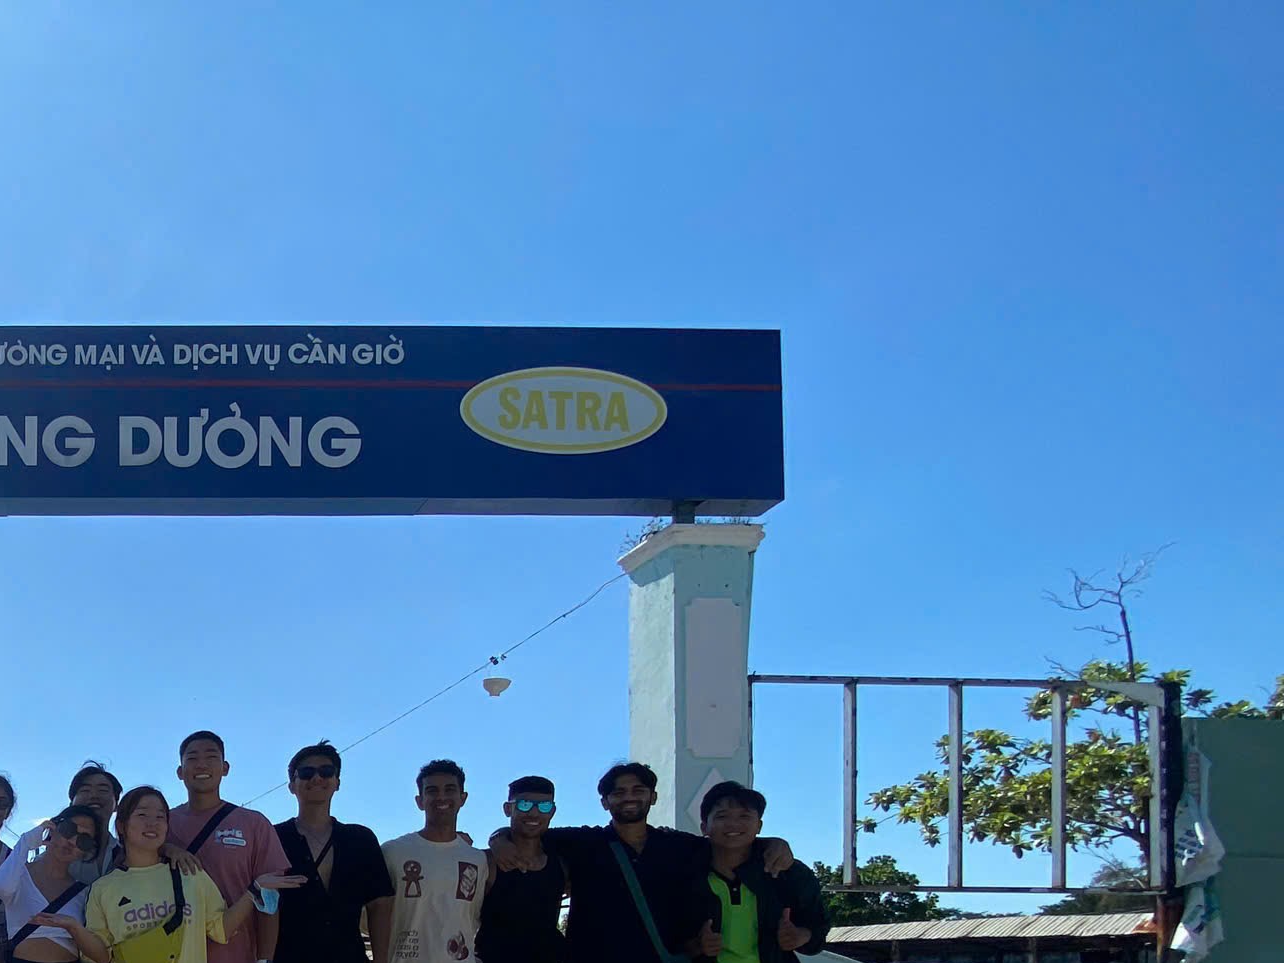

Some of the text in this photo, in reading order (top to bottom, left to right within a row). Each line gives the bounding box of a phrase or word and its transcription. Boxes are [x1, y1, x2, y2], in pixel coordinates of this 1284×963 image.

[75, 344, 124, 370] MẠI
[131, 334, 165, 365] VÀ
[174, 344, 238, 370] DỊCH
[244, 344, 280, 371] VỤ
[288, 333, 346, 365] CẦN
[352, 334, 405, 365] GIỜ
[497, 386, 631, 432] SATRA
